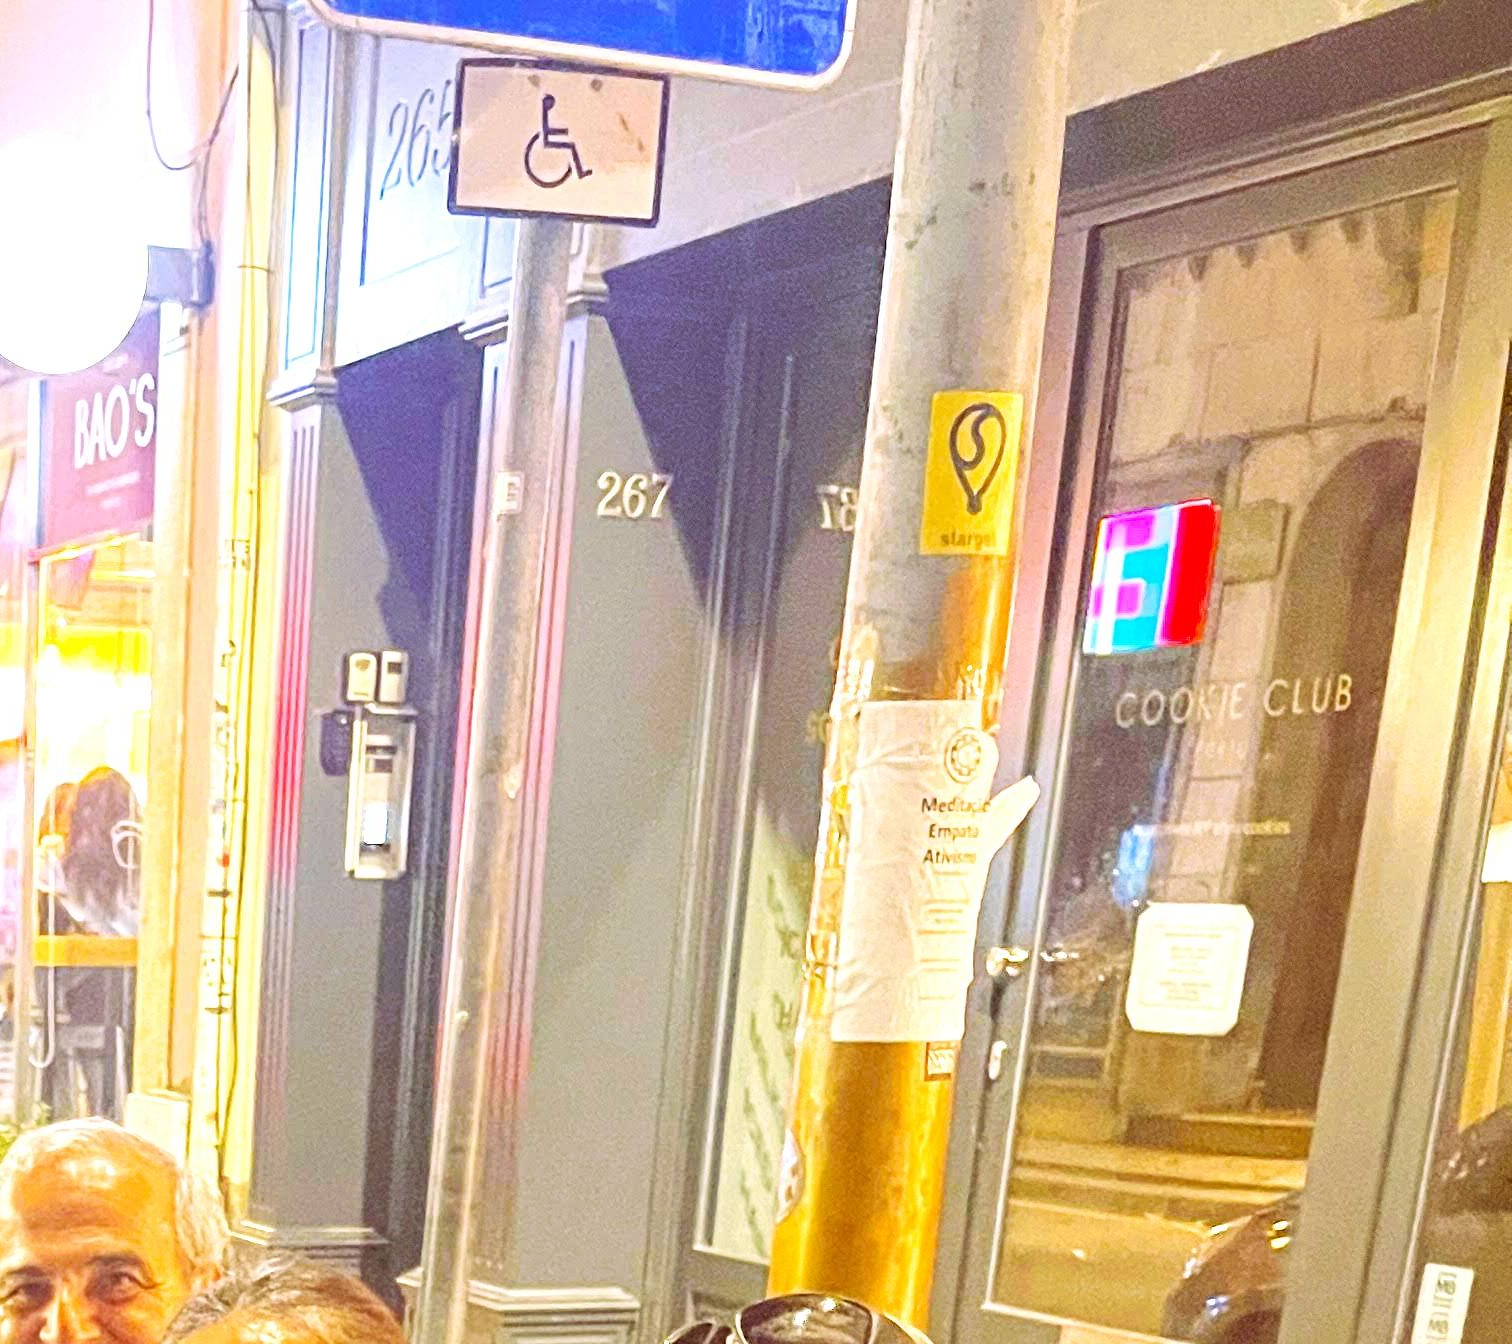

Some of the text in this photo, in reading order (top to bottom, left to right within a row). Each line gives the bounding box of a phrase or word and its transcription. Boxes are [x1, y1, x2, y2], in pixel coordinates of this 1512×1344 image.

[73, 372, 156, 470] BAO'S
[596, 470, 673, 520] 267
[1115, 673, 1353, 729] COOKIE CLUB
